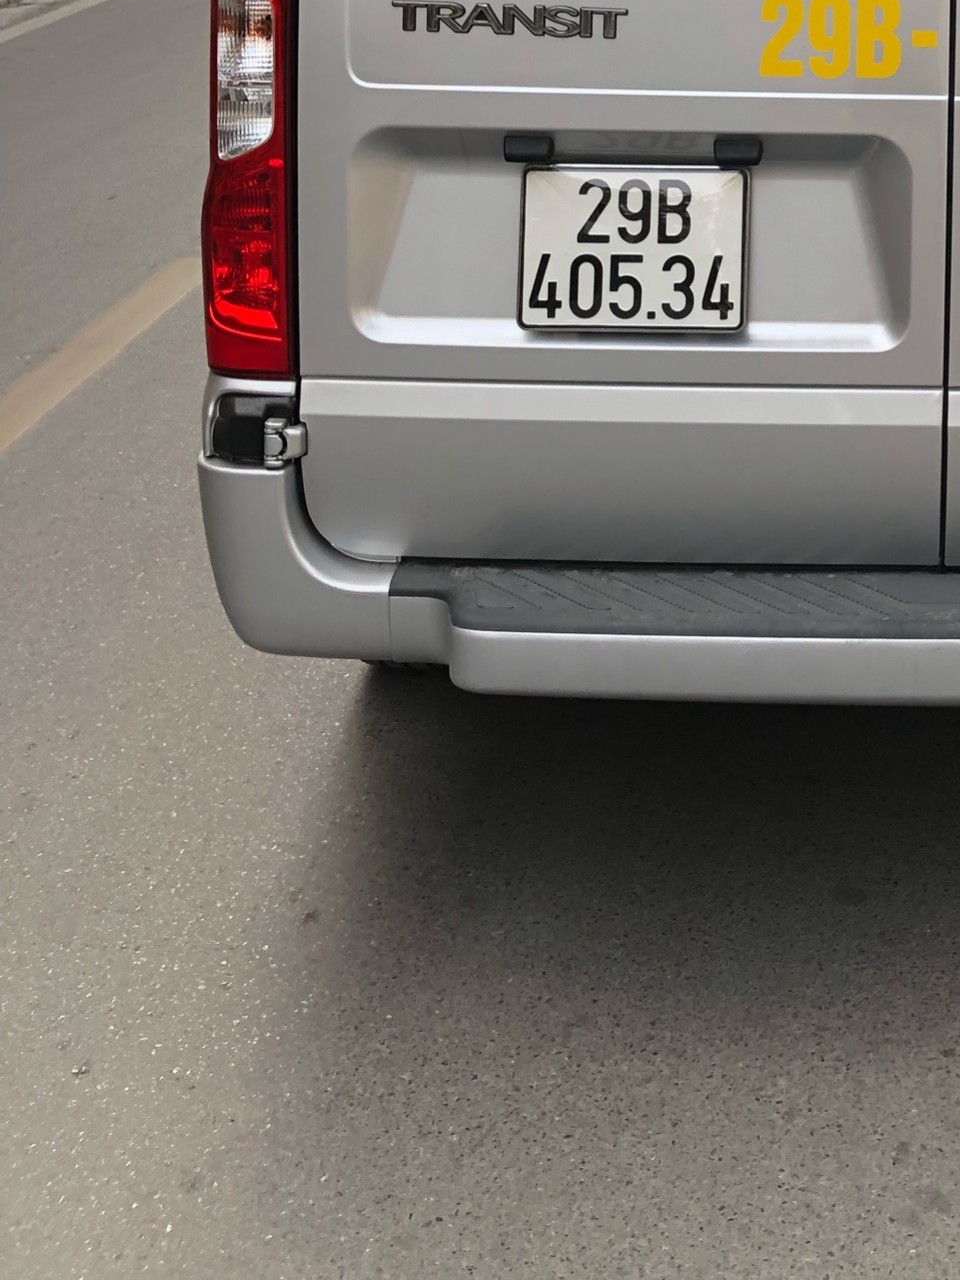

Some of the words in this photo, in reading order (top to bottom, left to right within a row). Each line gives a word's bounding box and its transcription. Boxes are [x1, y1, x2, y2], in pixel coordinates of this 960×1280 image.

[391, 0, 629, 39] TRANSIT
[577, 178, 692, 244] 29B
[529, 253, 734, 320] 405.34
